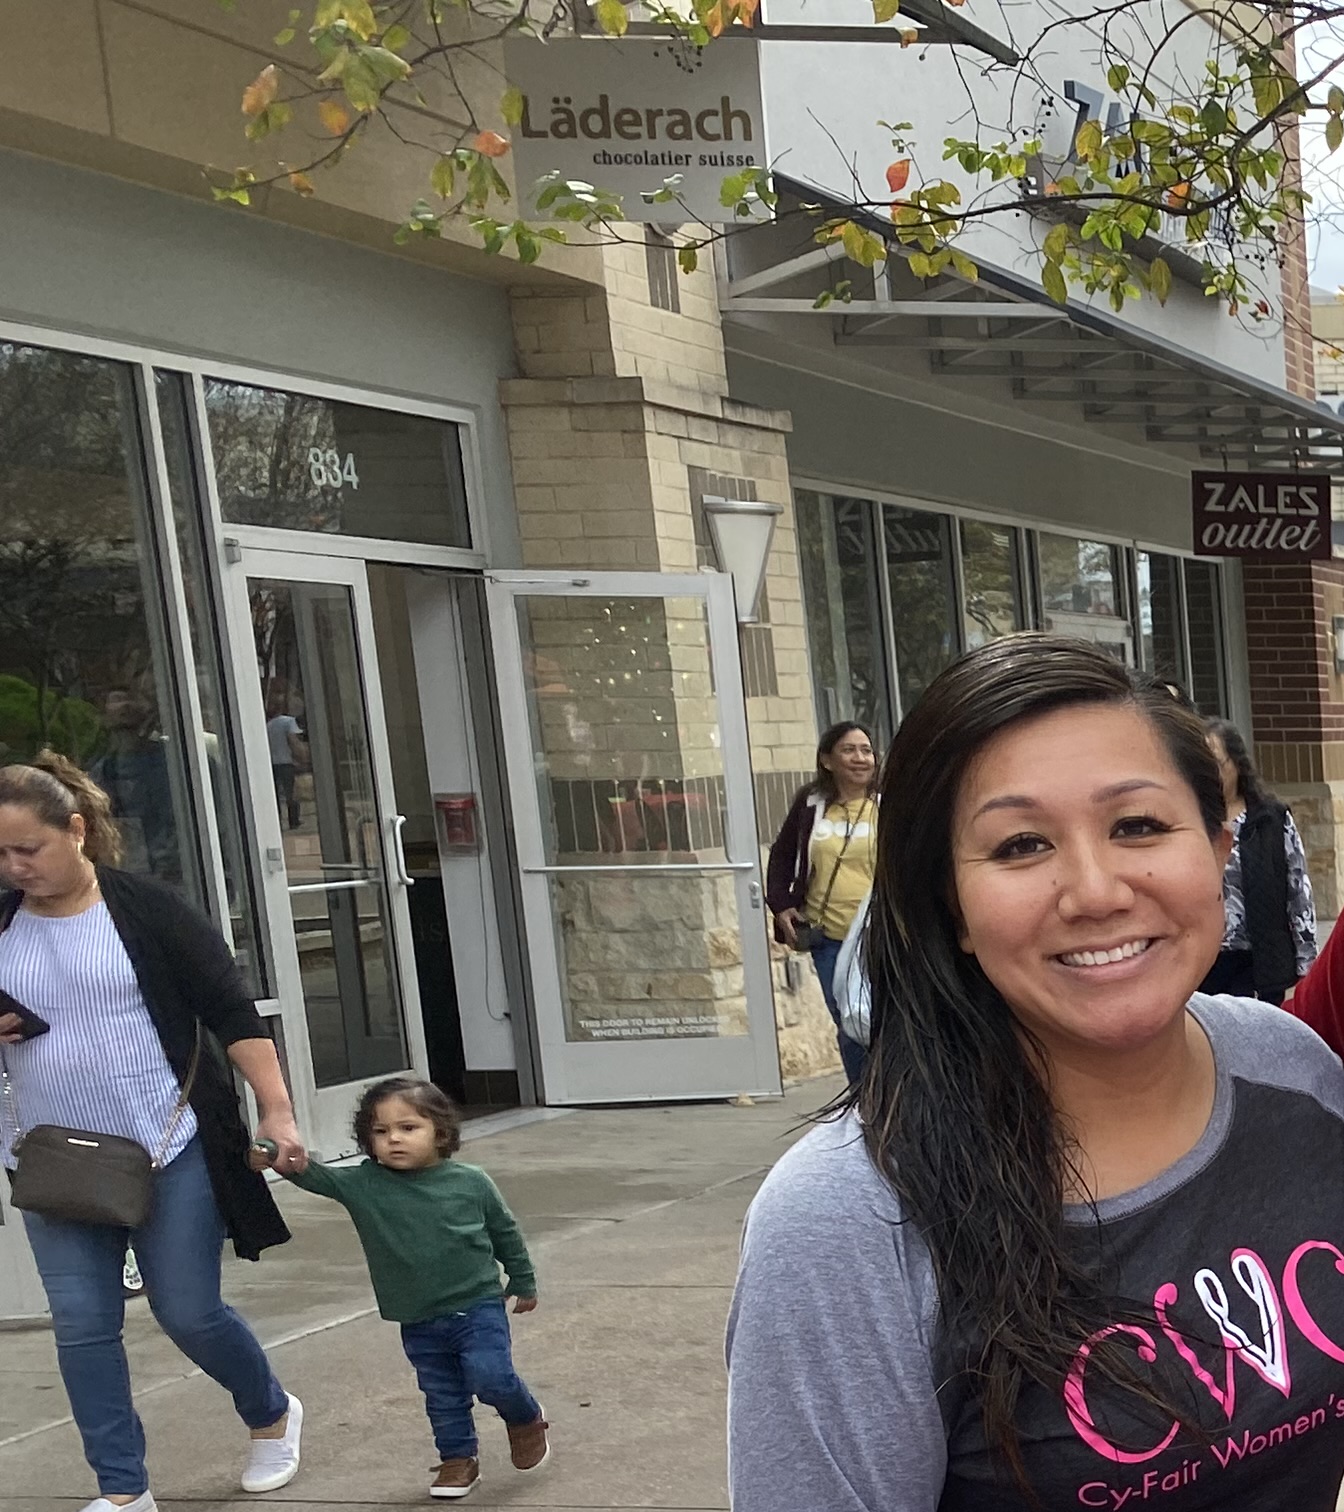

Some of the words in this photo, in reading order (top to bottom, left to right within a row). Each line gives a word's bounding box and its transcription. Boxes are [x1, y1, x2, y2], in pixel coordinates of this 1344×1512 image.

[521, 94, 752, 141] Läderach
[593, 150, 692, 166] chocolatier
[699, 152, 755, 166] suisse
[307, 447, 360, 490] 834
[1203, 482, 1319, 516] ZALES
[1201, 518, 1321, 550] outlet
[1078, 1460, 1202, 1511] Cy-Fair
